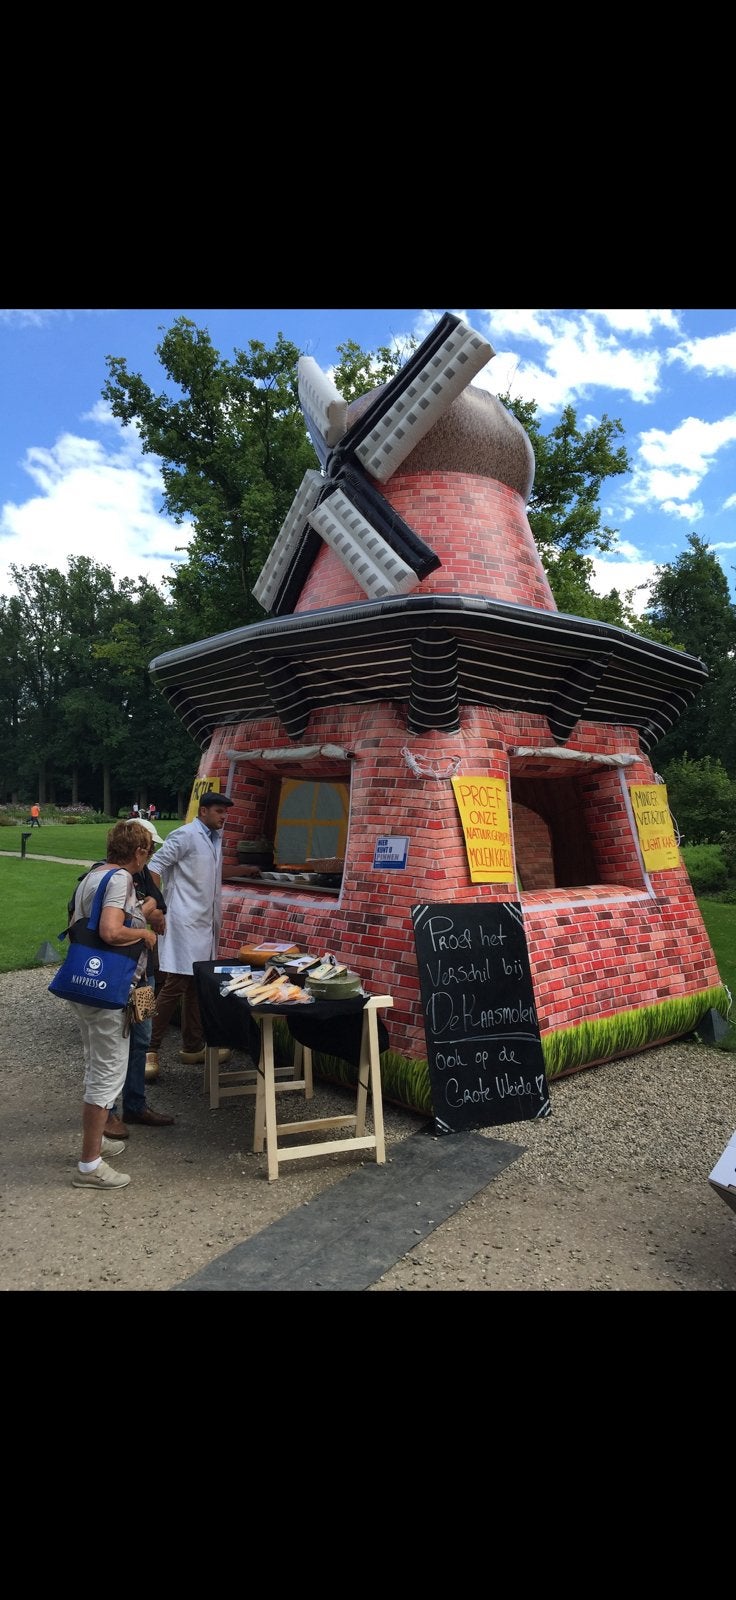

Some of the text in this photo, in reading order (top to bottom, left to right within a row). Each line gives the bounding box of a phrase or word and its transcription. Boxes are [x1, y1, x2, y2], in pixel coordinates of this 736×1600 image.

[459, 785, 502, 809] PROEF
[634, 790, 658, 808] MINDER
[469, 810, 498, 826] ONZE
[641, 837, 661, 852] LIGHT
[479, 924, 508, 946] het
[502, 958, 524, 980] bij
[72, 975, 99, 988] NAVPRESS
[475, 1051, 489, 1070] op
[498, 1045, 522, 1065] de
